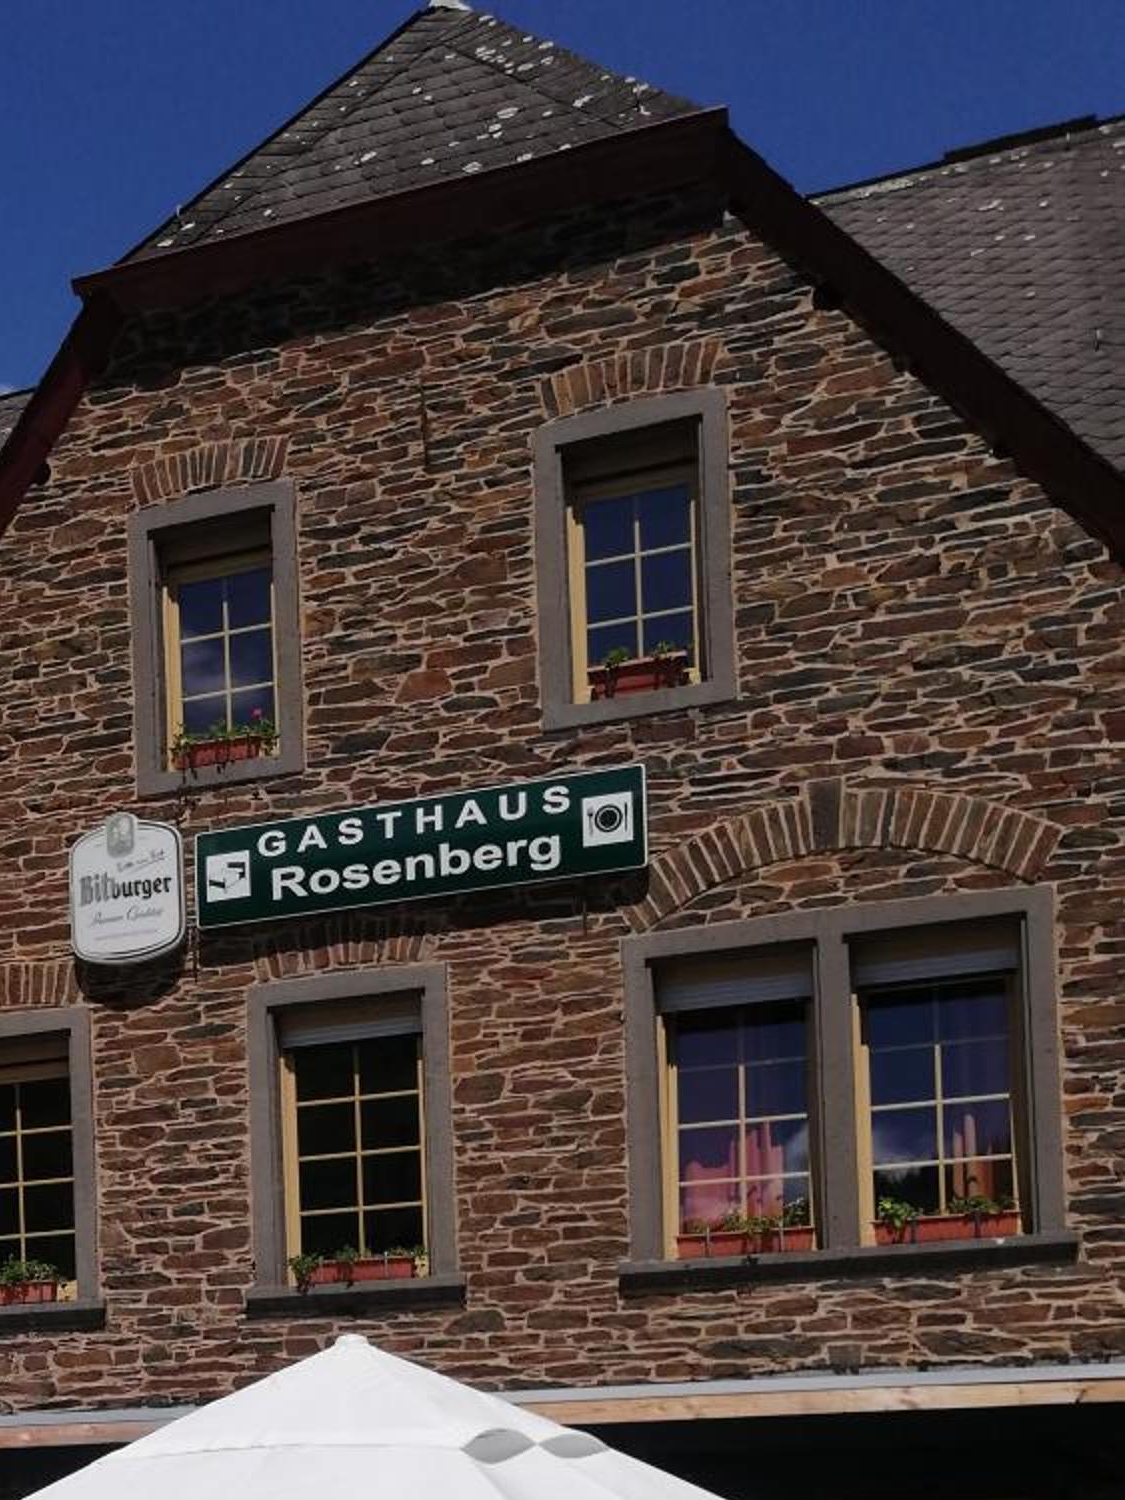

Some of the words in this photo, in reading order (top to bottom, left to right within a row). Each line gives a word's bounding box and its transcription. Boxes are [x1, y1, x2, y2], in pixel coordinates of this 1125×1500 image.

[256, 784, 571, 858] GASTHAUS
[79, 872, 172, 907] Bitburger
[271, 834, 562, 901] Rosenberg
